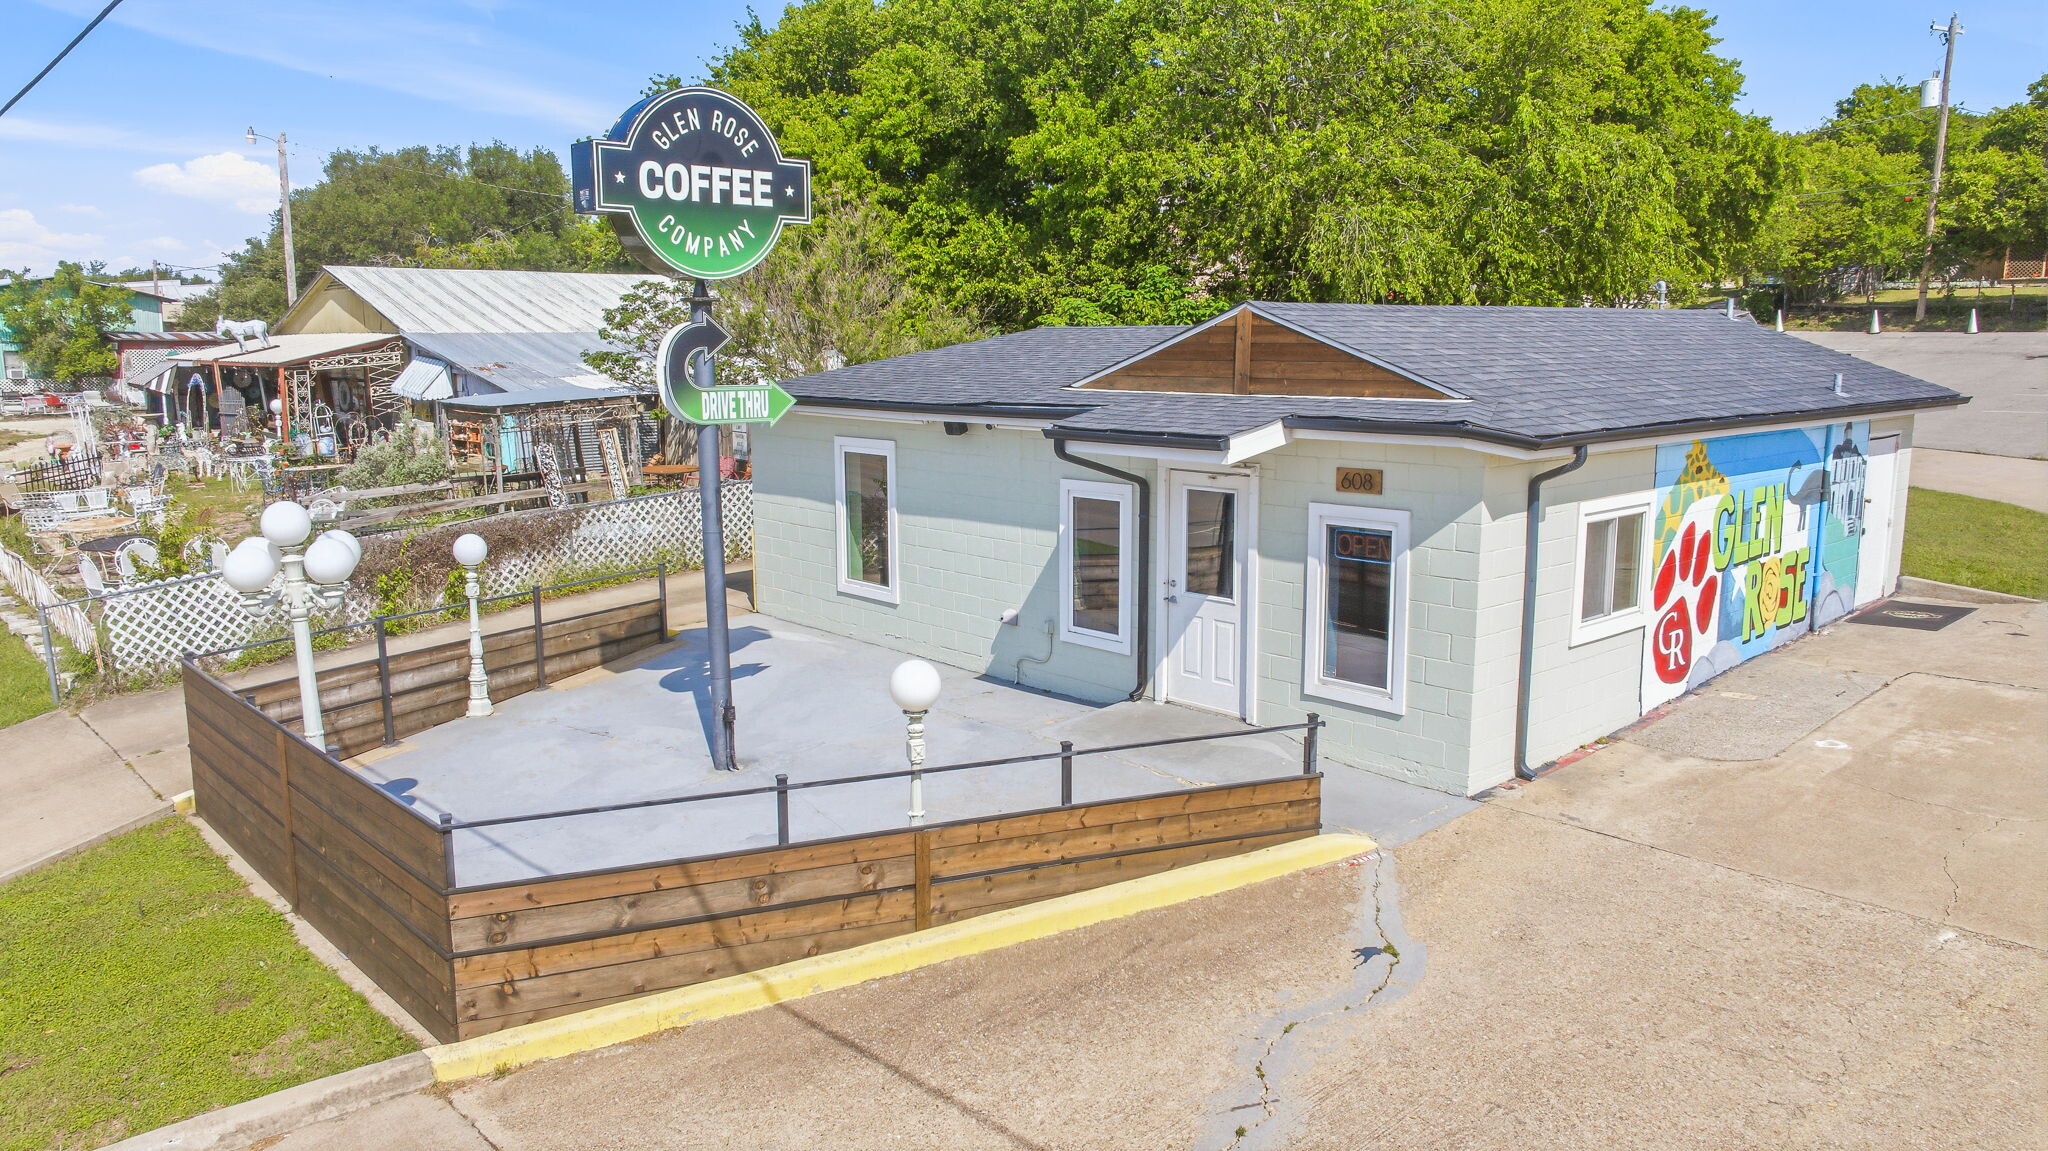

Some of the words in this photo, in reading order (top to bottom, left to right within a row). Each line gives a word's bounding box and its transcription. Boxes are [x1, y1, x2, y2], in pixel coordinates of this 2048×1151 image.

[652, 107, 701, 150] GLEN
[711, 110, 760, 158] ROSE
[638, 160, 774, 208] COFFEE
[658, 214, 756, 258] COMPANY
[701, 391, 737, 420] DRIVE
[737, 390, 769, 418] THRU
[1341, 472, 1373, 490] 608
[1338, 533, 1391, 560] OPEN
[1712, 483, 1785, 573] GLEN
[1742, 547, 1810, 644] ROSE
